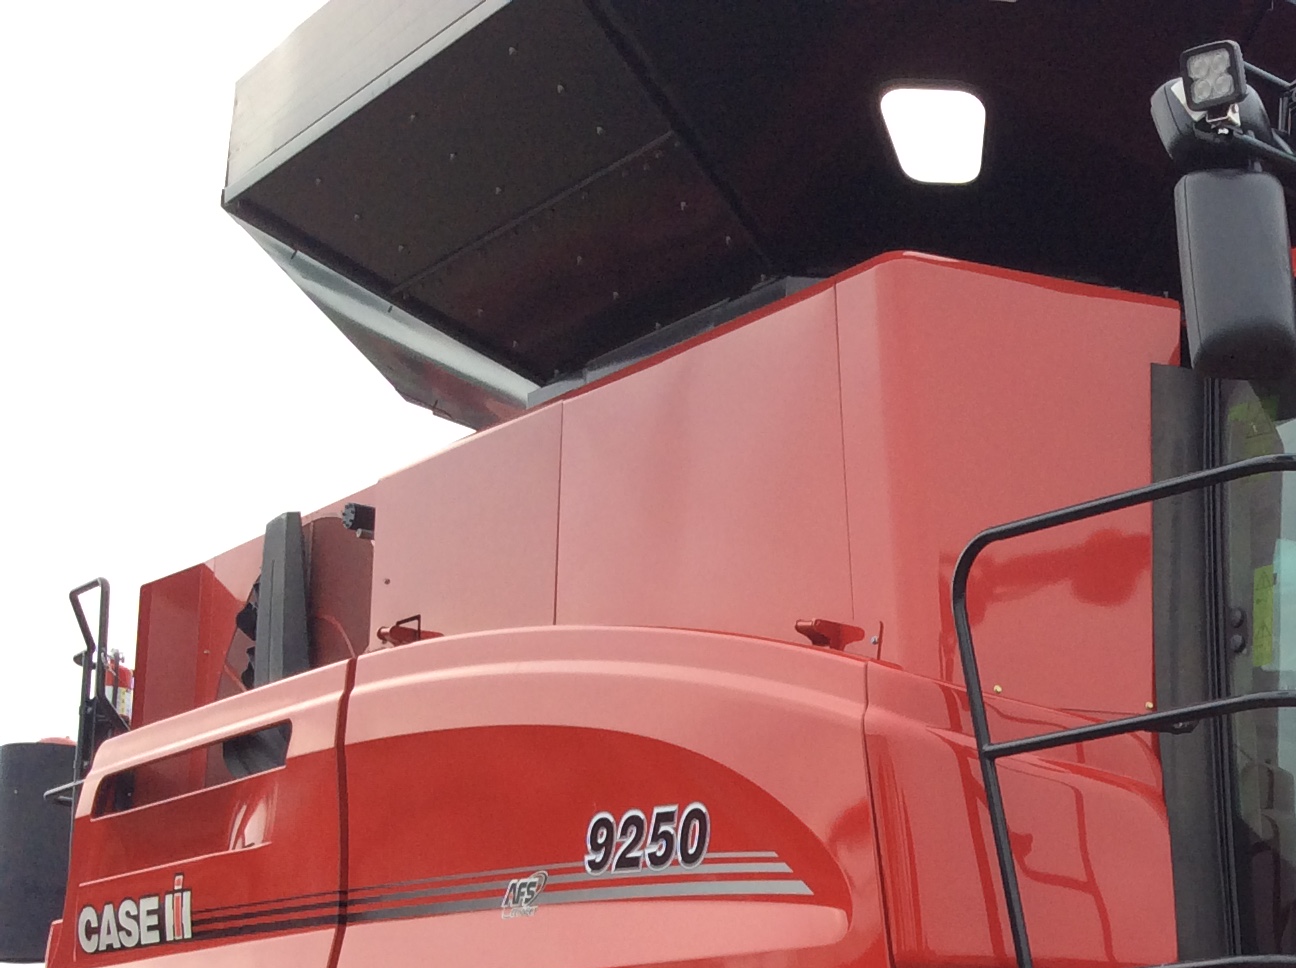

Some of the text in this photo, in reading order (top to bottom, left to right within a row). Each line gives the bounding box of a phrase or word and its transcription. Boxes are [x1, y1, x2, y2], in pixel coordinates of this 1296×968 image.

[584, 802, 711, 876] 9250
[501, 878, 540, 908] AFS
[78, 895, 160, 954] CASE
